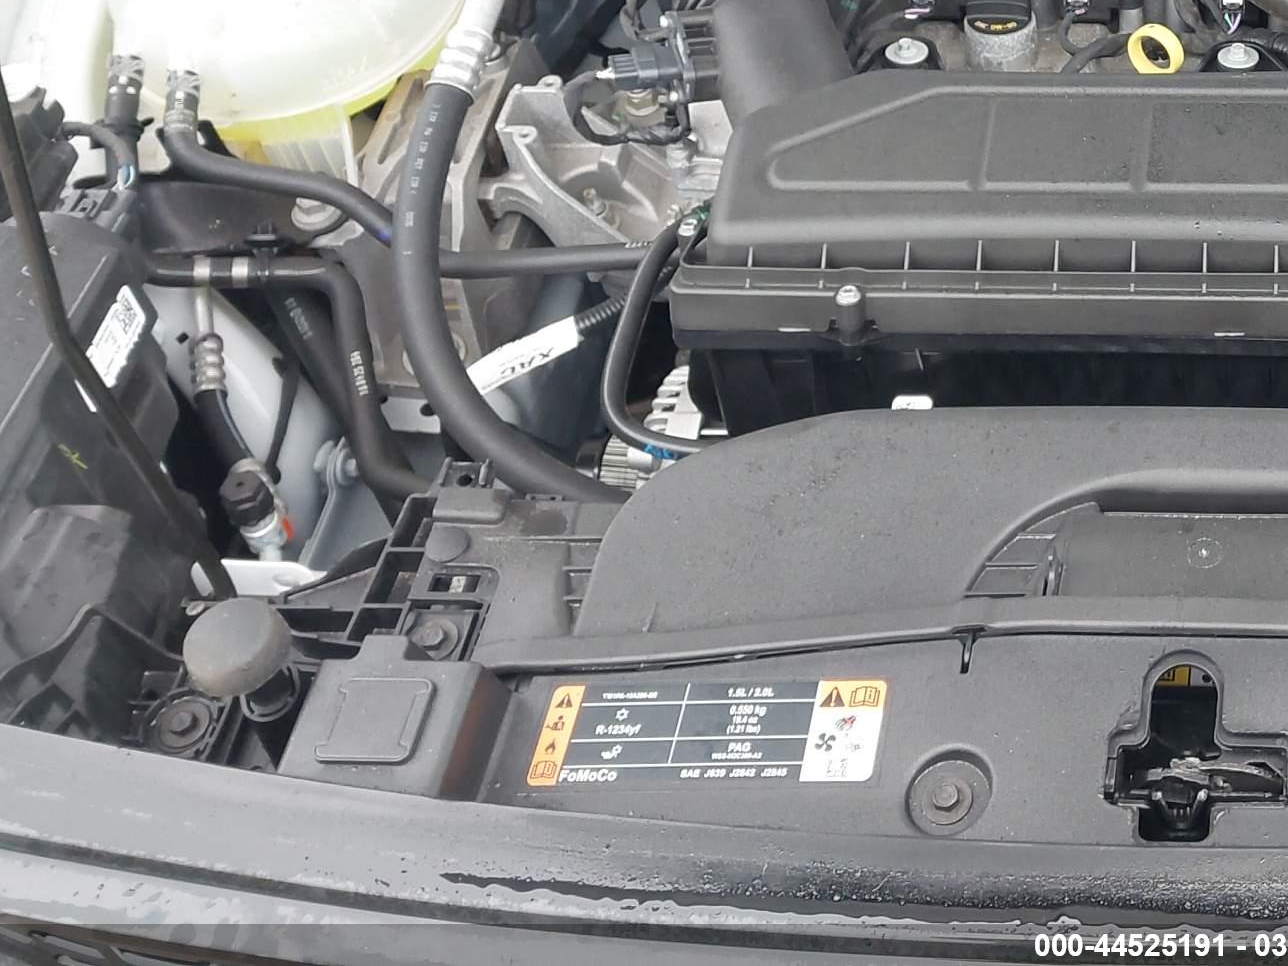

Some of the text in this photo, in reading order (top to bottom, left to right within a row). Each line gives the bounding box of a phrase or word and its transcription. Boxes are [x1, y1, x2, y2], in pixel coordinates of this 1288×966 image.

[754, 704, 767, 717] kg
[595, 724, 642, 737] R-1234yf
[728, 742, 752, 752] PAG
[559, 768, 617, 782] FoMoCo
[680, 769, 701, 778] SAE
